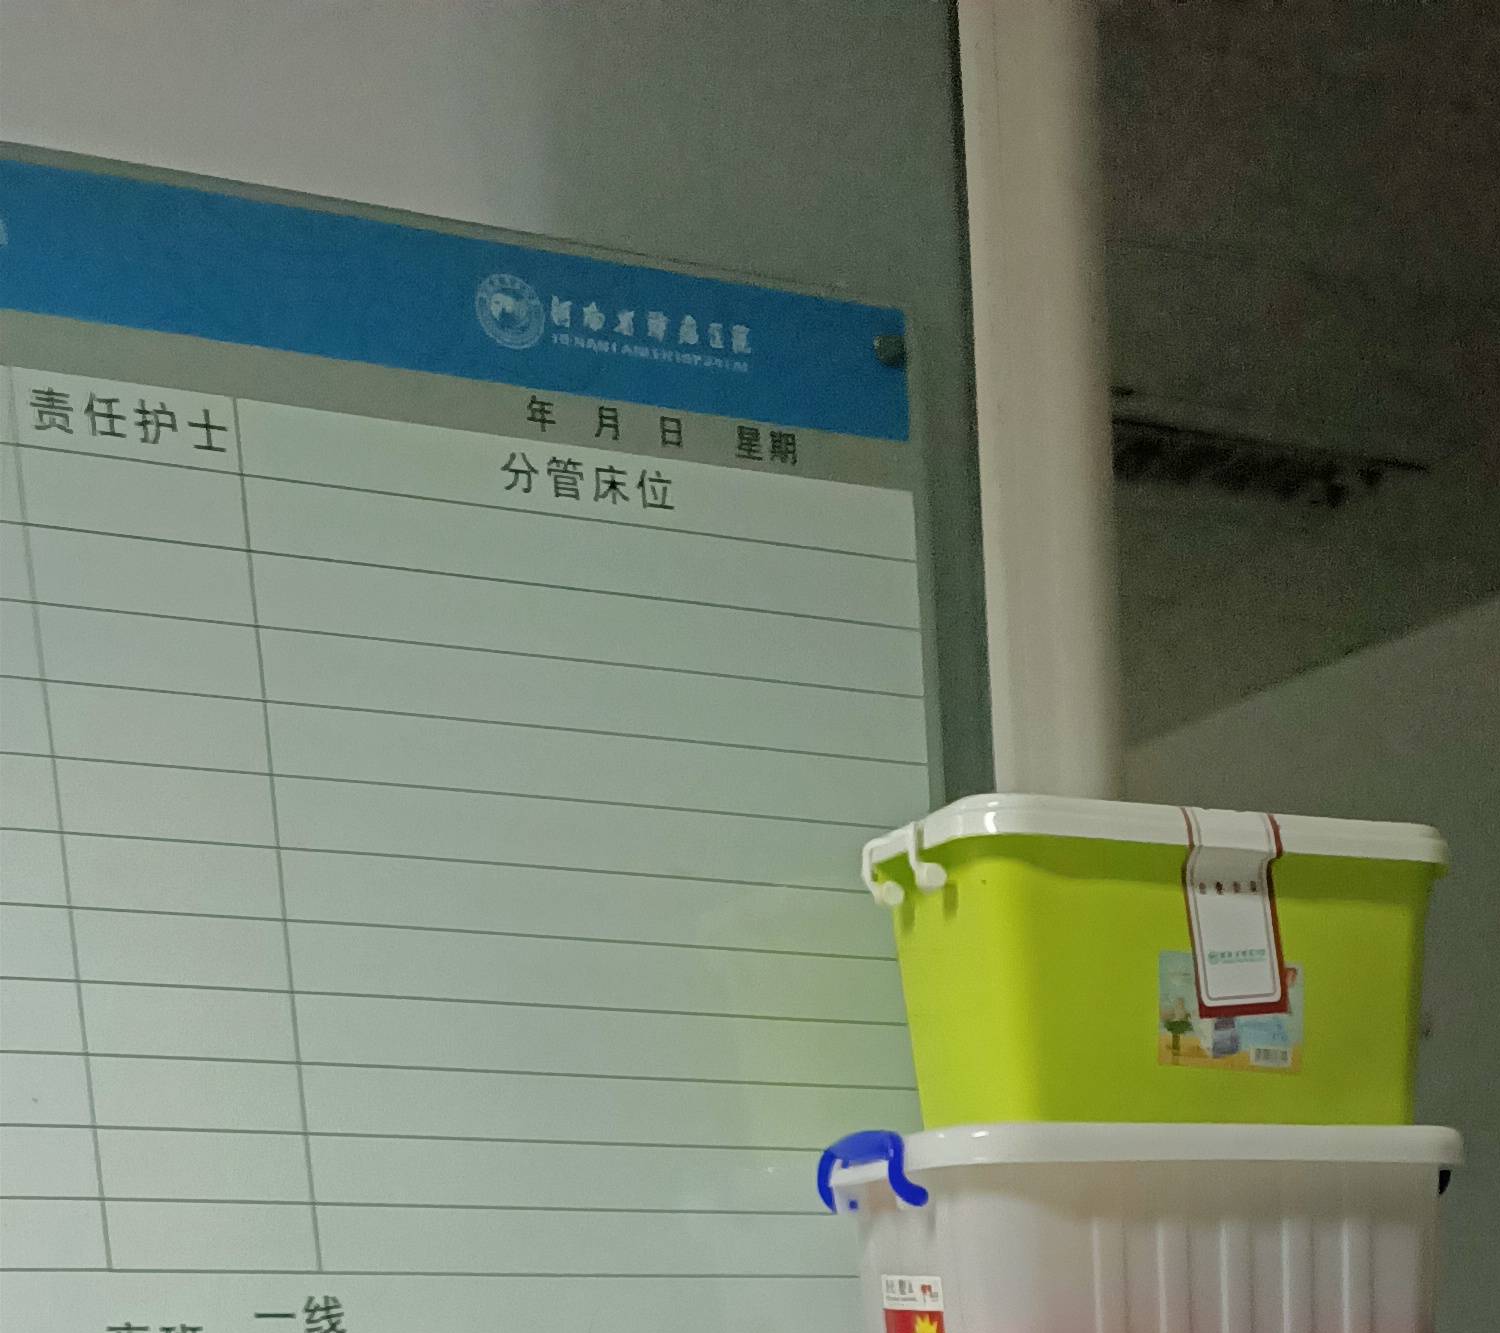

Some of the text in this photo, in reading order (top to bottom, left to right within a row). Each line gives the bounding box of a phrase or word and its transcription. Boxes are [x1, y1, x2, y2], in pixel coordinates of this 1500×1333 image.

[29, 386, 229, 453] 责任护士
[526, 394, 798, 466] 年 月 日 星期
[501, 452, 676, 510] 分管床位
